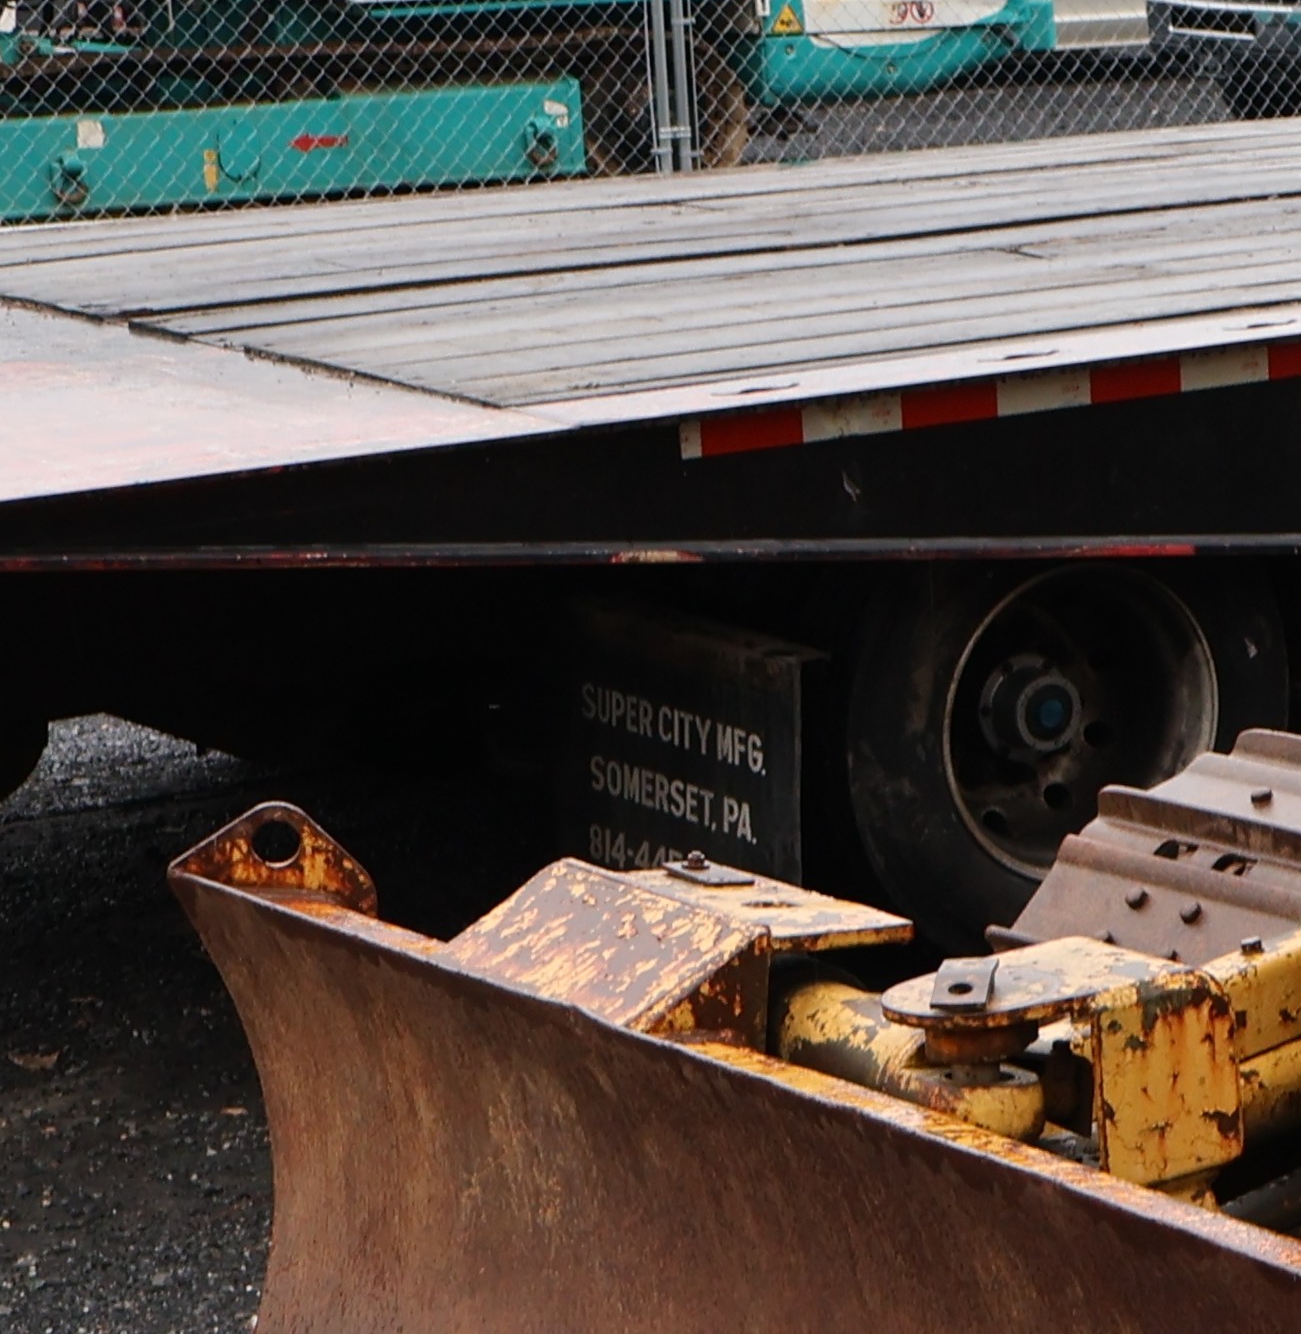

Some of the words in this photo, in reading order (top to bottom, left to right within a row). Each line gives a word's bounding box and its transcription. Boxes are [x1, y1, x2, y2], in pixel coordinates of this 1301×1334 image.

[581, 682, 654, 738] SUPER
[658, 704, 712, 756] CITY
[716, 722, 767, 777] MFG.
[590, 755, 717, 832] SOMERSET,
[723, 795, 758, 845] PA.
